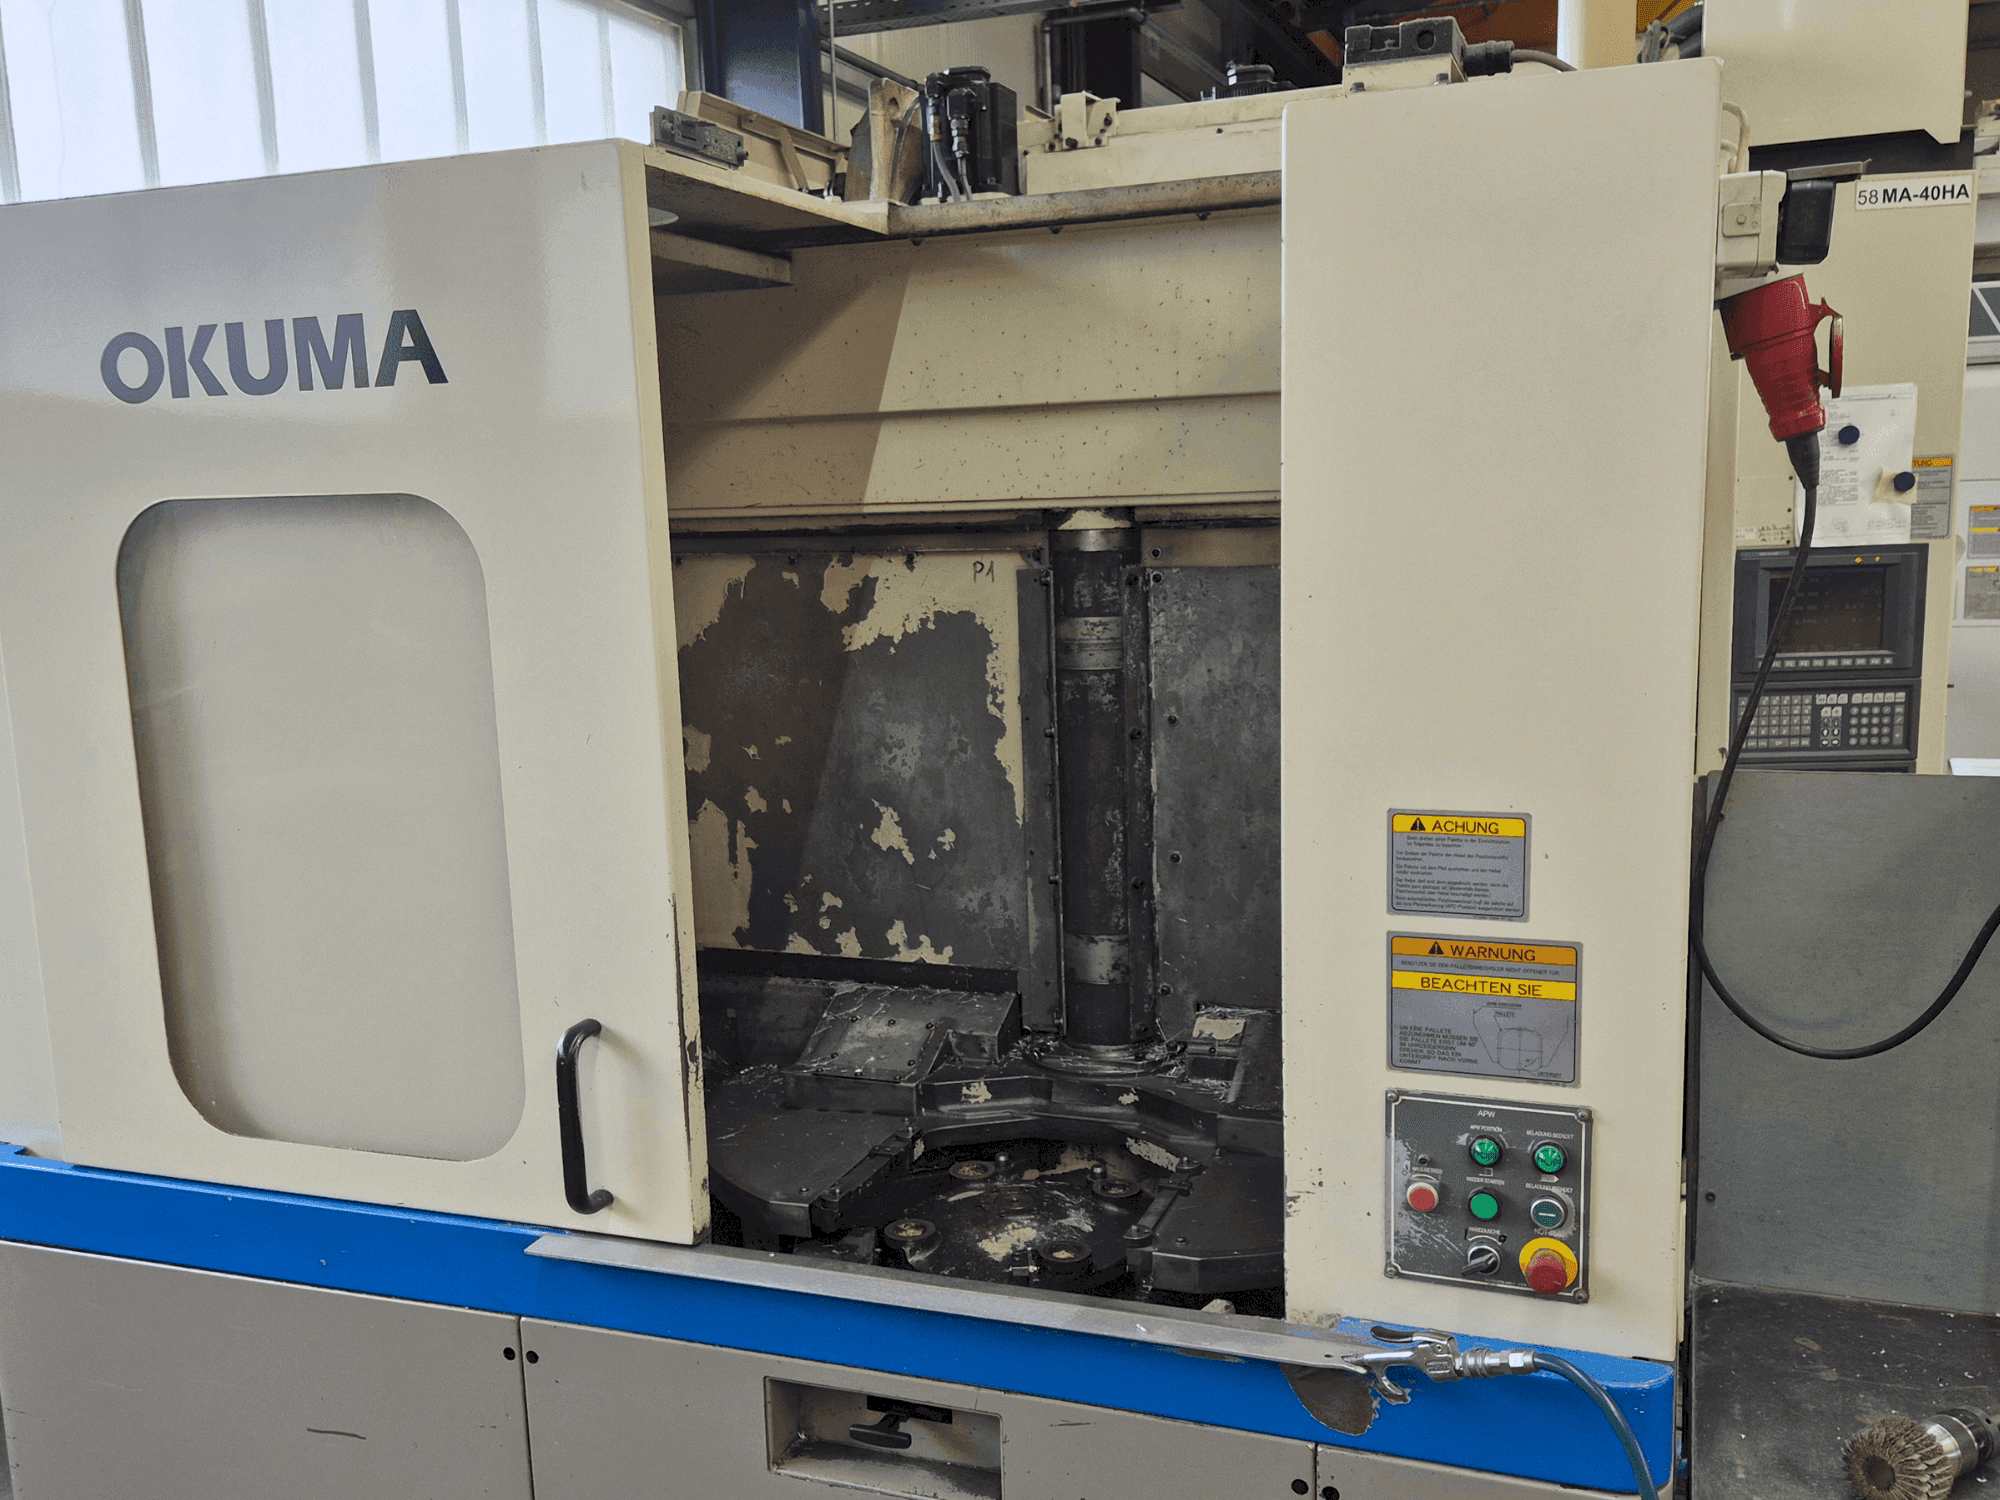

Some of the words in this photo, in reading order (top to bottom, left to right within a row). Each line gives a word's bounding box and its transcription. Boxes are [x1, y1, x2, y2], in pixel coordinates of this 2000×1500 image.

[1857, 188, 1879, 206] 58
[1882, 183, 1970, 204] MA-40HA
[100, 309, 449, 404] OKUMA
[972, 560, 995, 584] P1
[1432, 819, 1499, 835] ACHUNG
[1450, 944, 1536, 962] WARNUNG
[1421, 976, 1512, 996] BEACHTEN
[1517, 983, 1543, 997] SIE
[1477, 1109, 1496, 1118] APW
